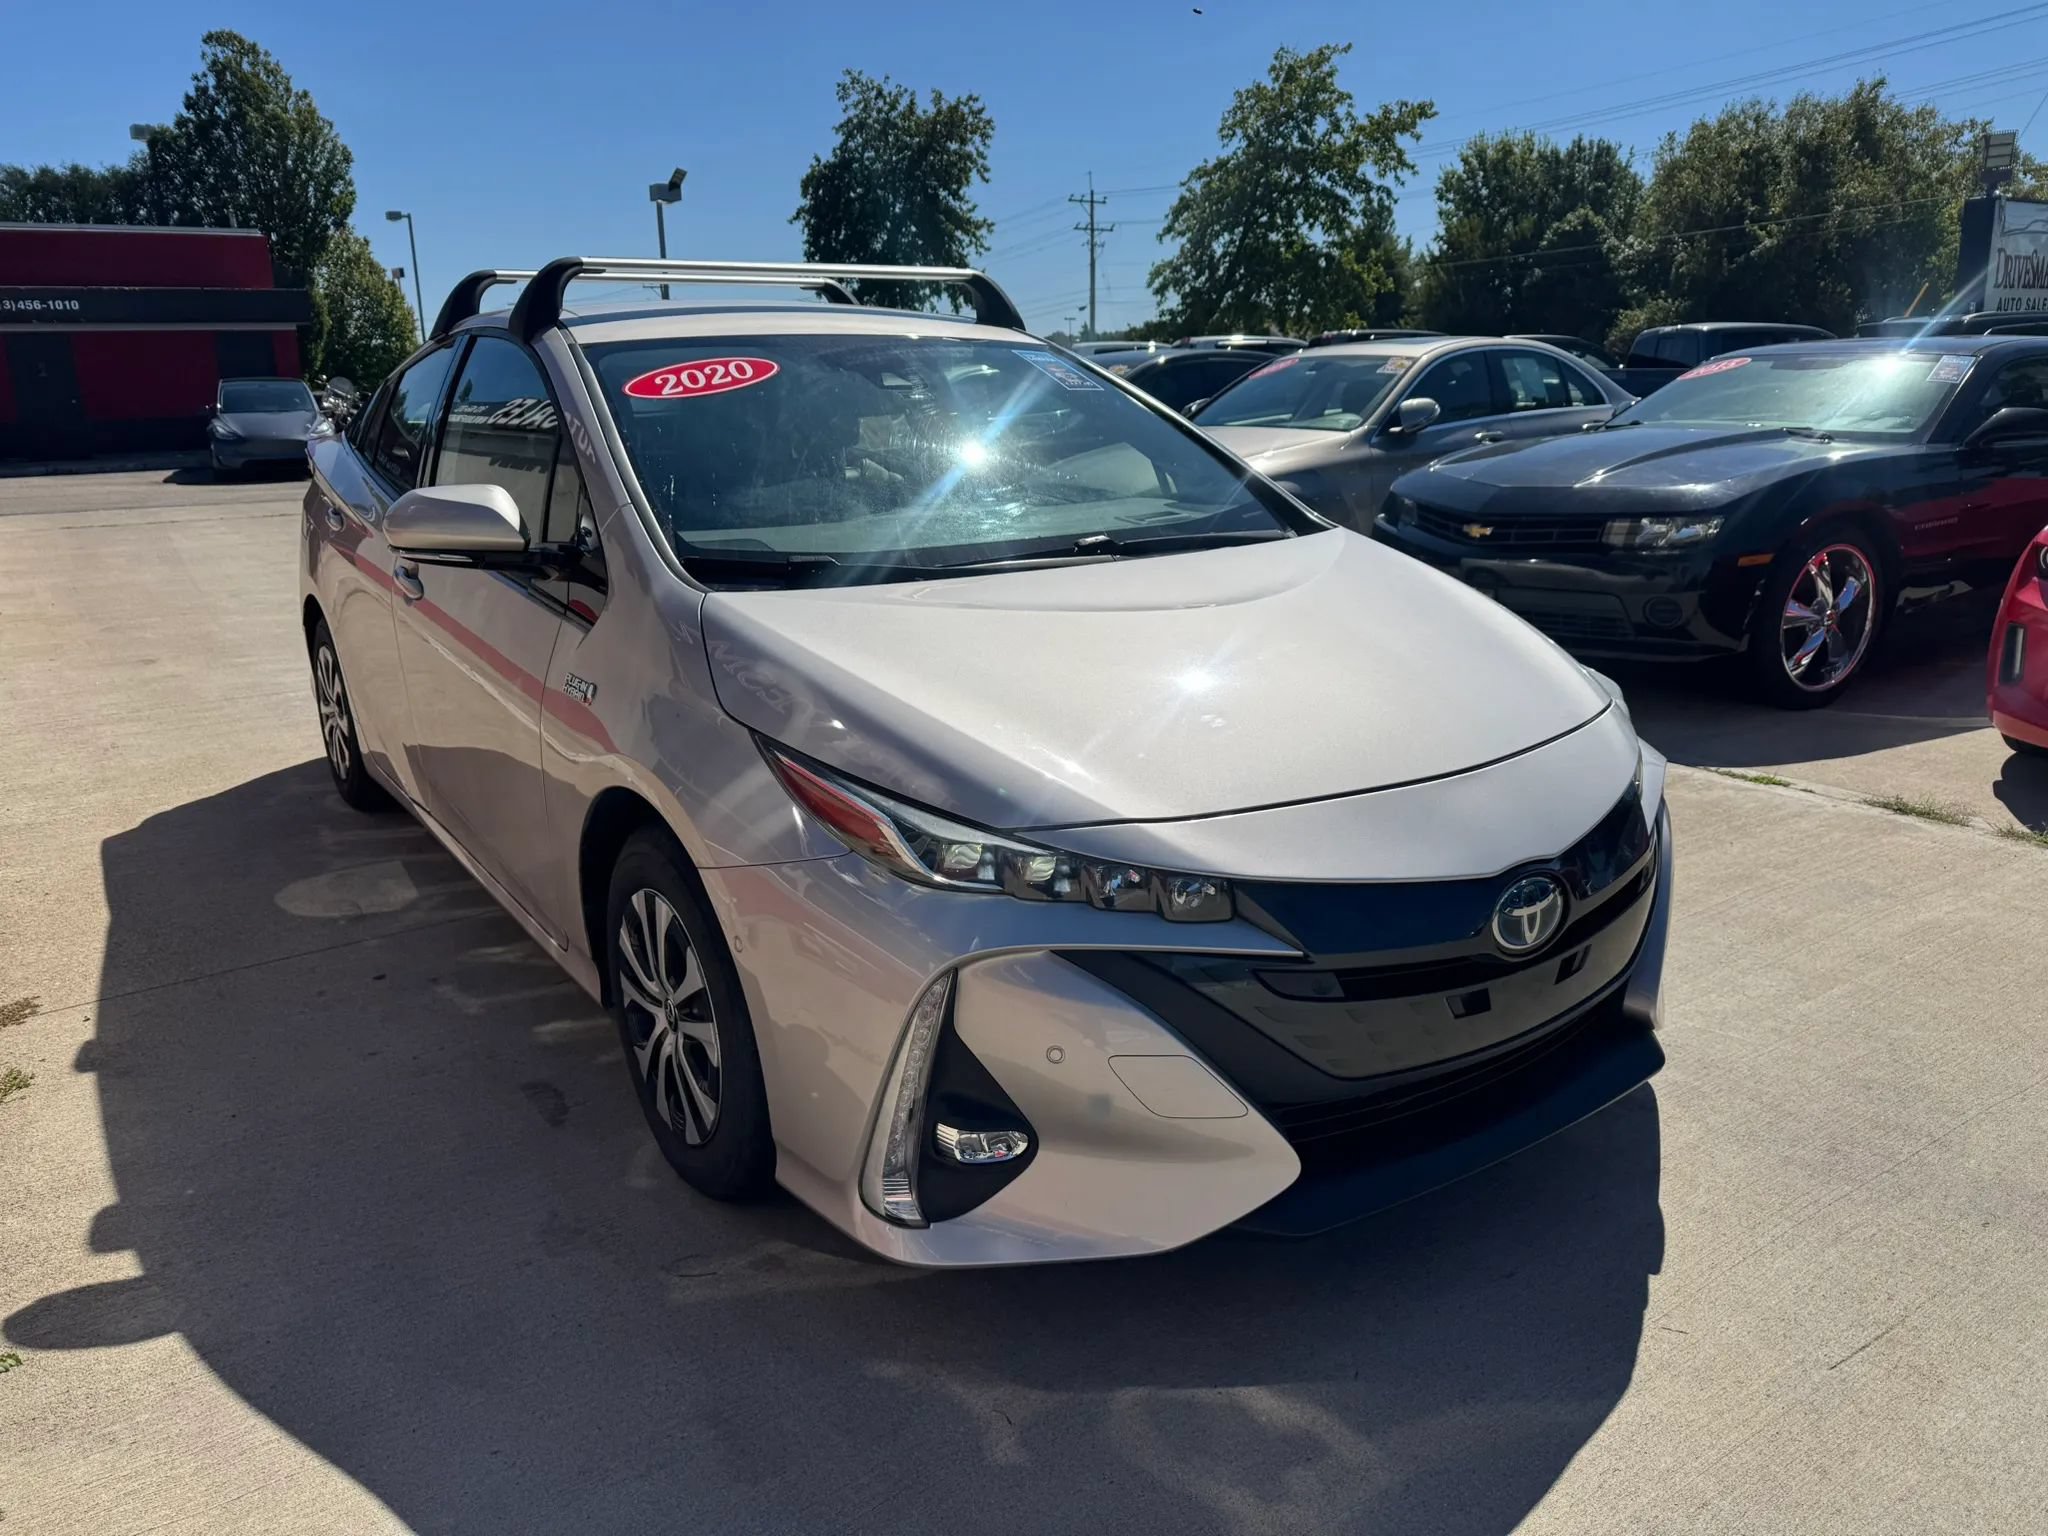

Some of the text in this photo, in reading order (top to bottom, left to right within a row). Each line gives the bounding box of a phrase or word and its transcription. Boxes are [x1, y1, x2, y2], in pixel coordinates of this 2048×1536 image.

[0, 299, 79, 312] 3)456-1010
[1996, 297, 2022, 312] AUTO
[654, 361, 754, 395] 2020
